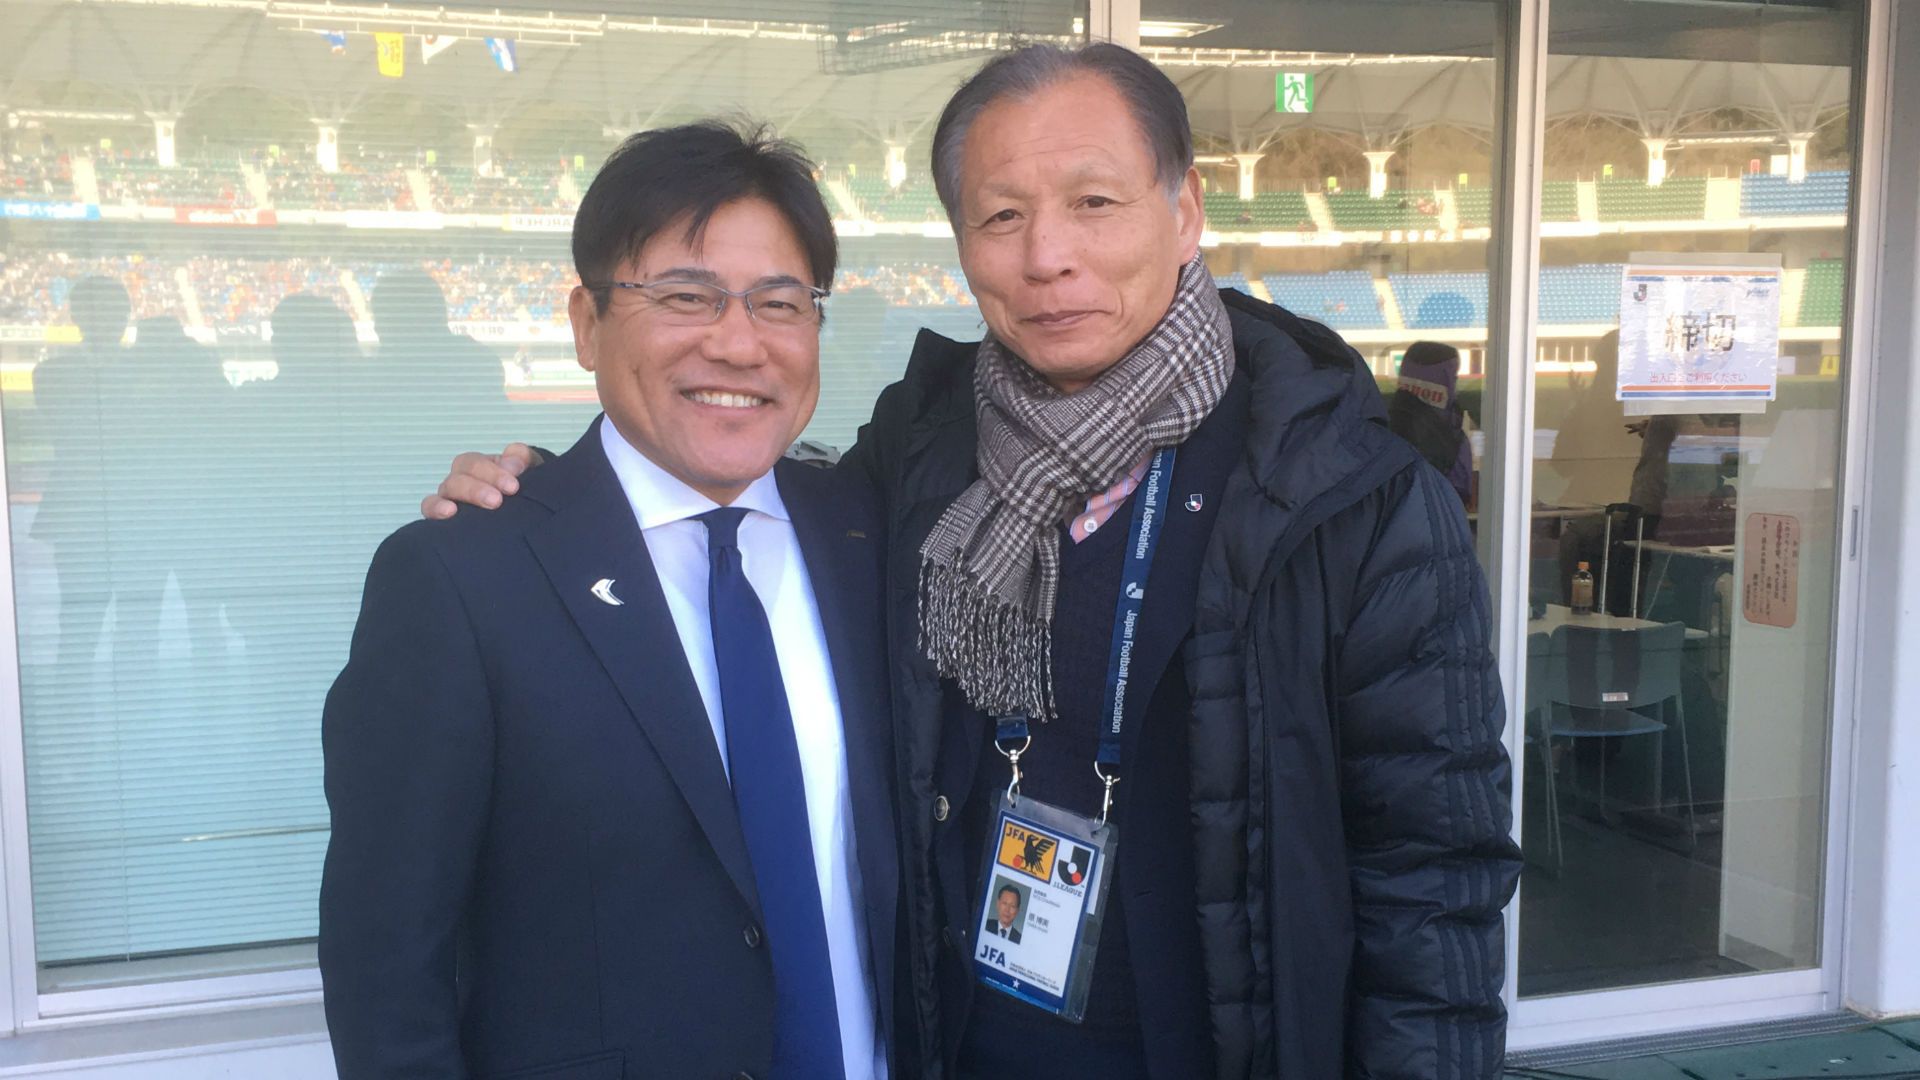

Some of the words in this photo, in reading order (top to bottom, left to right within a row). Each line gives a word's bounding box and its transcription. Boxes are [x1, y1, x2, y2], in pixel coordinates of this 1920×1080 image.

[1145, 470, 1162, 506] Football
[1136, 507, 1155, 560] Association
[1124, 609, 1138, 639] Japan
[1119, 640, 1134, 678] Football
[1112, 679, 1127, 734] Association
[1005, 826, 1026, 843] JFA
[979, 944, 1006, 968] JFA
